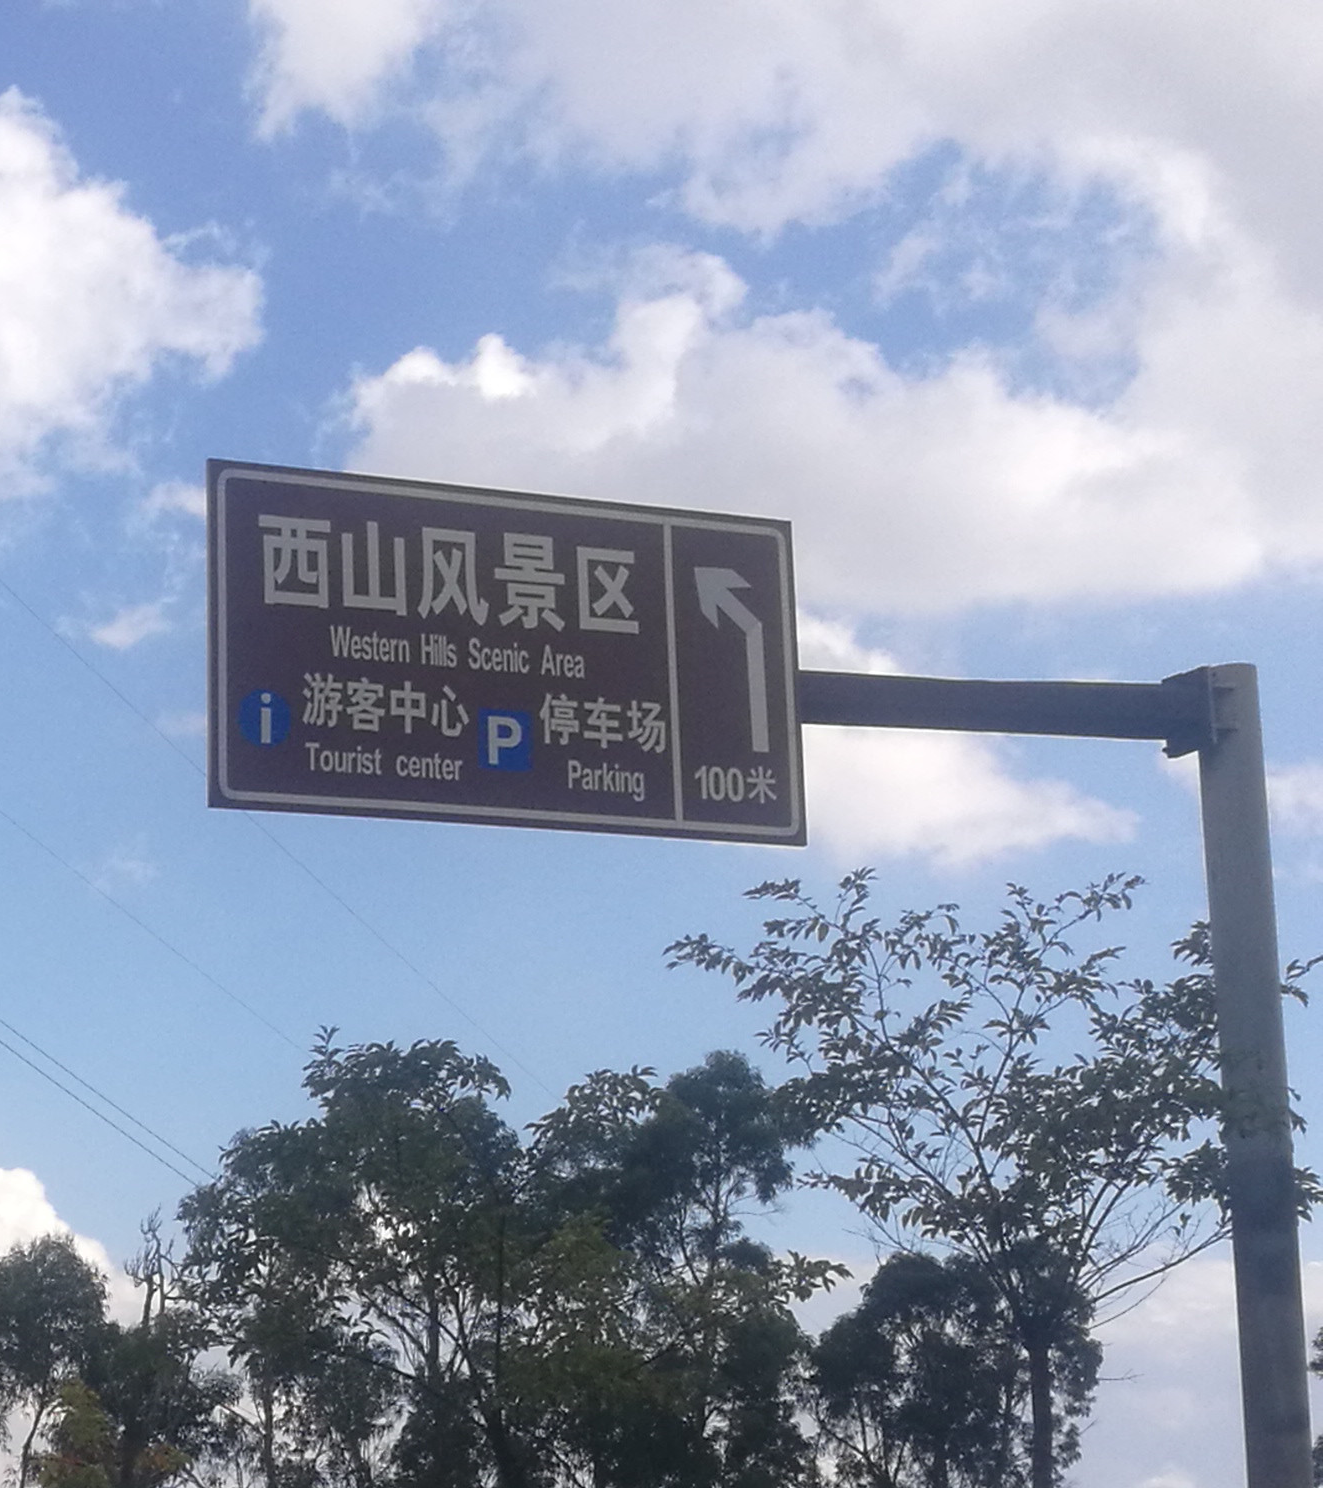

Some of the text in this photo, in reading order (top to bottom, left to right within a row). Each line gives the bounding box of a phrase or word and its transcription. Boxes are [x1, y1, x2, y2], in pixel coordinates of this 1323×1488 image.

[258, 514, 640, 635] 西山风景区
[329, 625, 586, 679] Western Hills Scenic Area
[302, 672, 470, 738] 游客中心
[539, 693, 666, 754] 停车场
[305, 742, 463, 782] Tourist center
[487, 715, 523, 766] P
[568, 760, 646, 802] Parking
[694, 765, 777, 804] 100米
